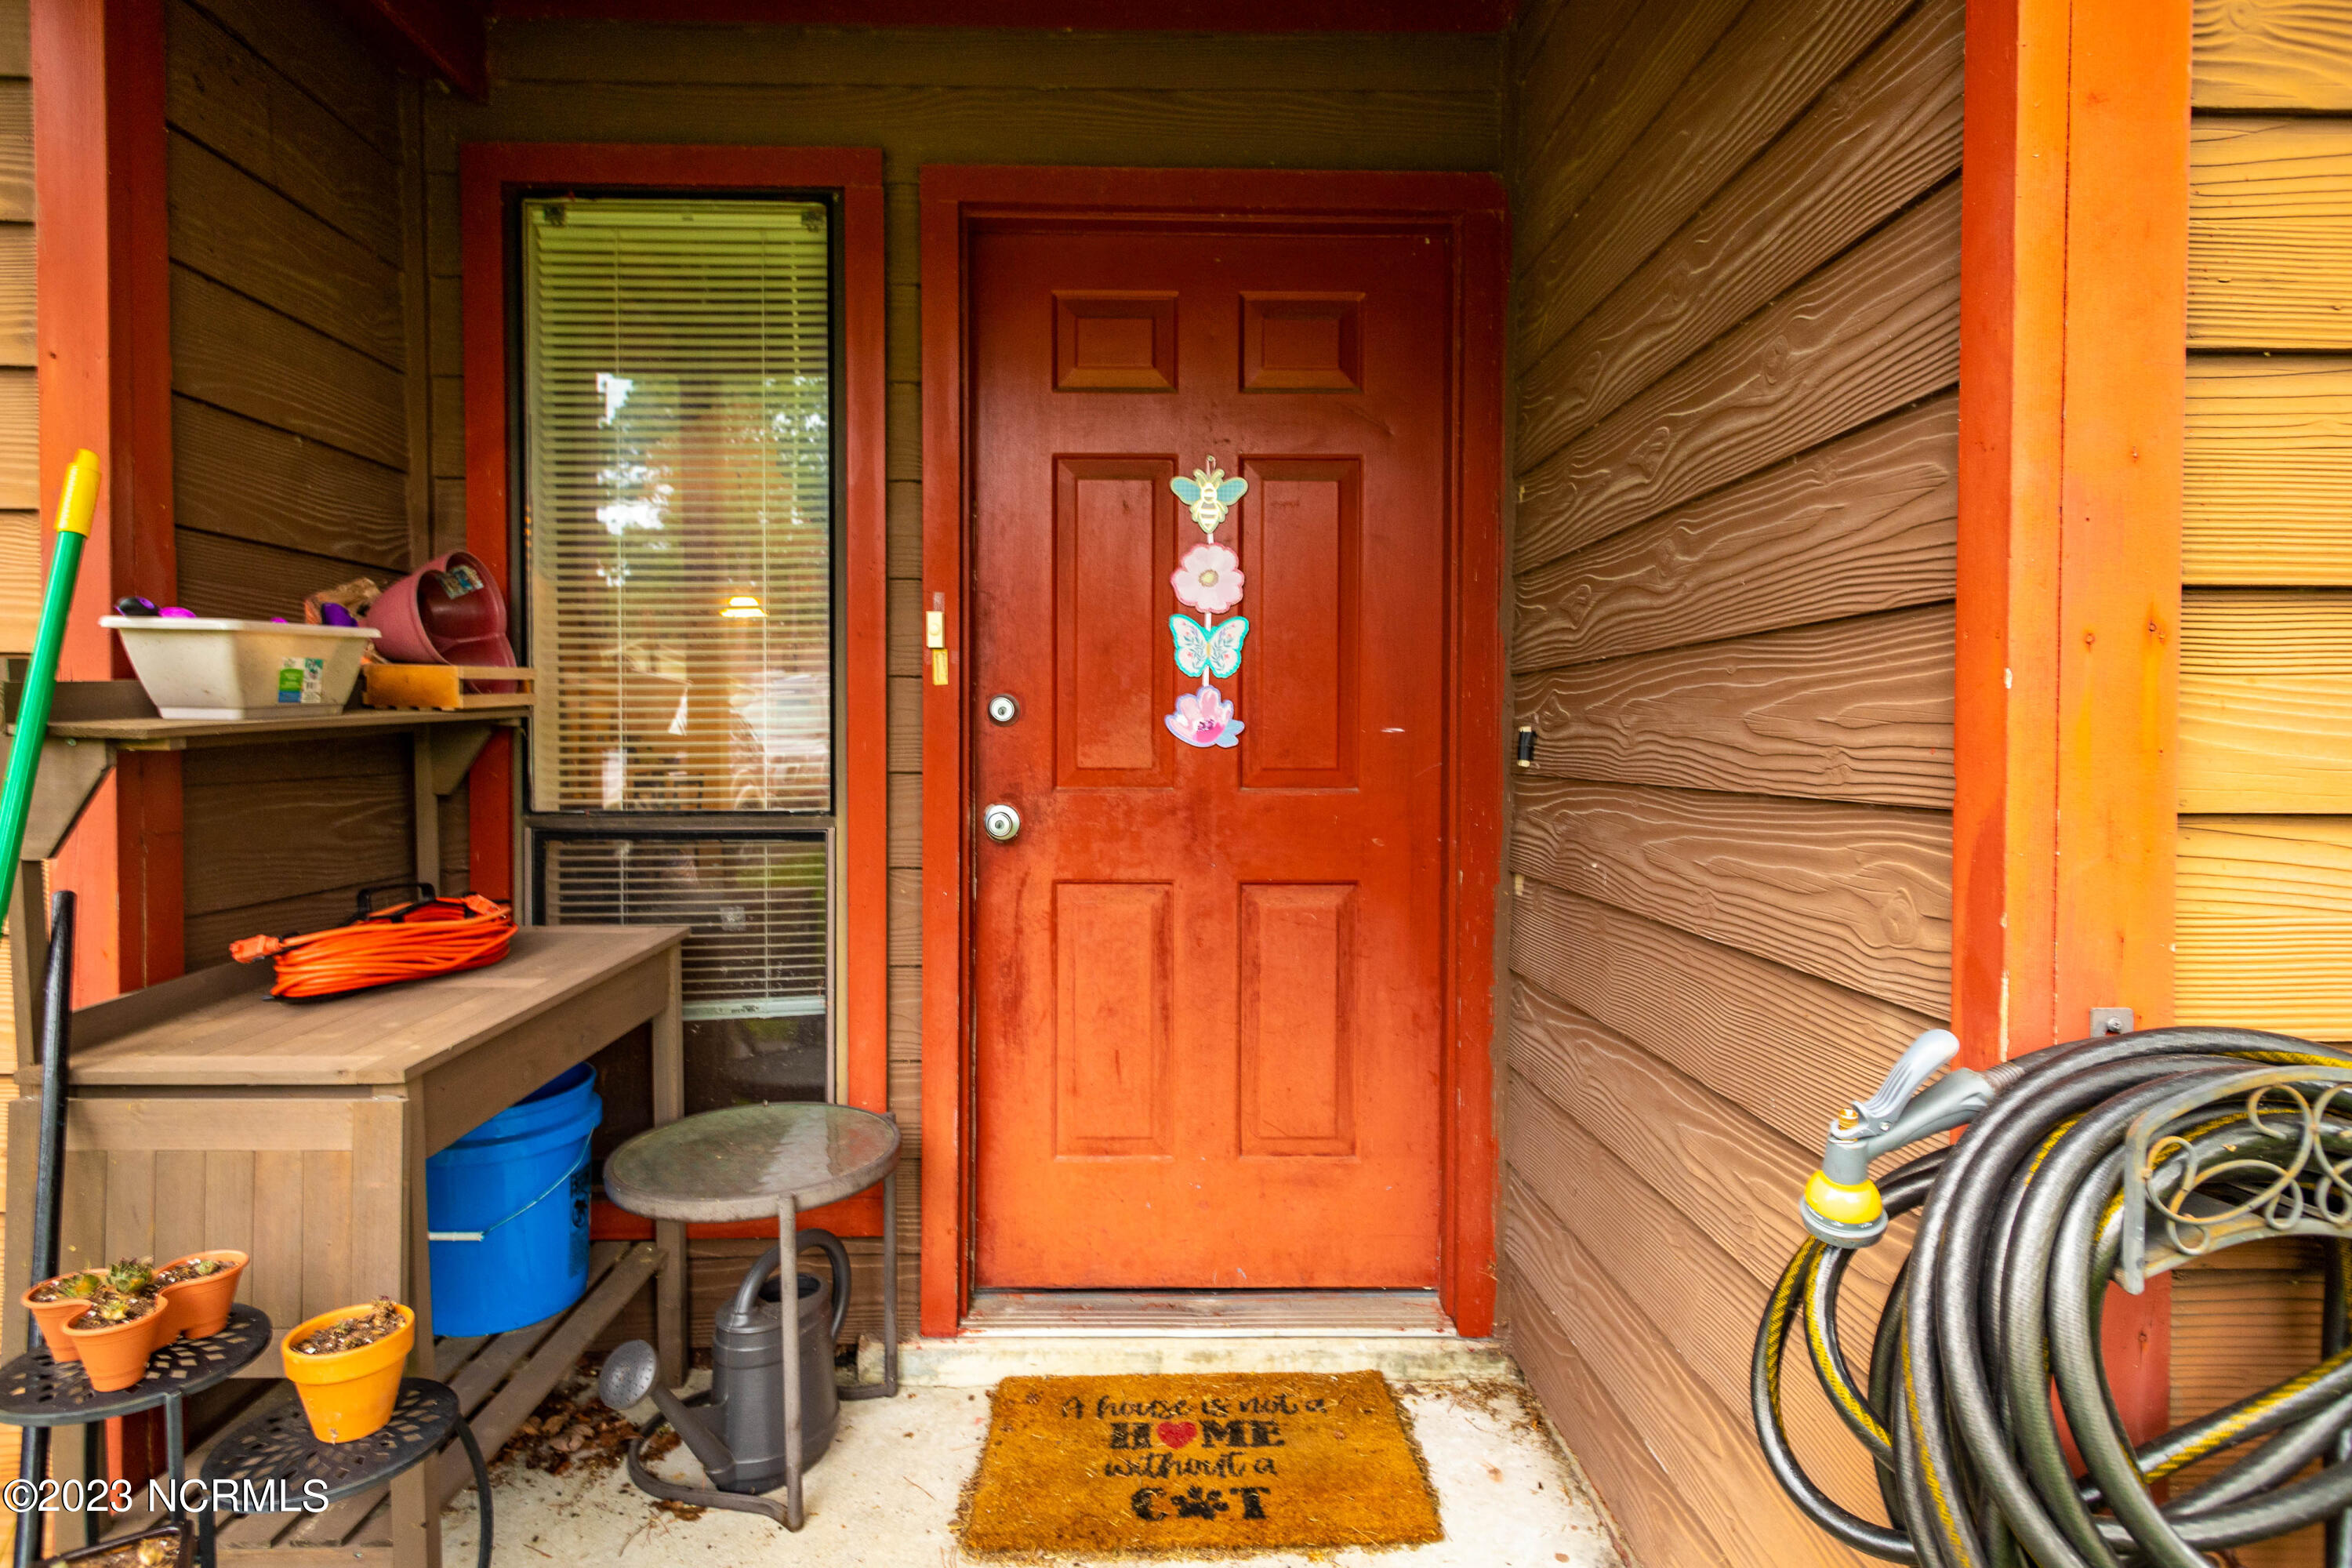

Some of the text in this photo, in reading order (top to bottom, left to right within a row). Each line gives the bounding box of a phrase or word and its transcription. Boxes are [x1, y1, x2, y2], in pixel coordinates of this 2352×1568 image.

[1097, 1395, 1189, 1419] house
[1201, 1397, 1230, 1417] is
[1239, 1392, 1298, 1415] not
[1305, 1398, 1328, 1414] a
[1104, 1451, 1278, 1479] without a
